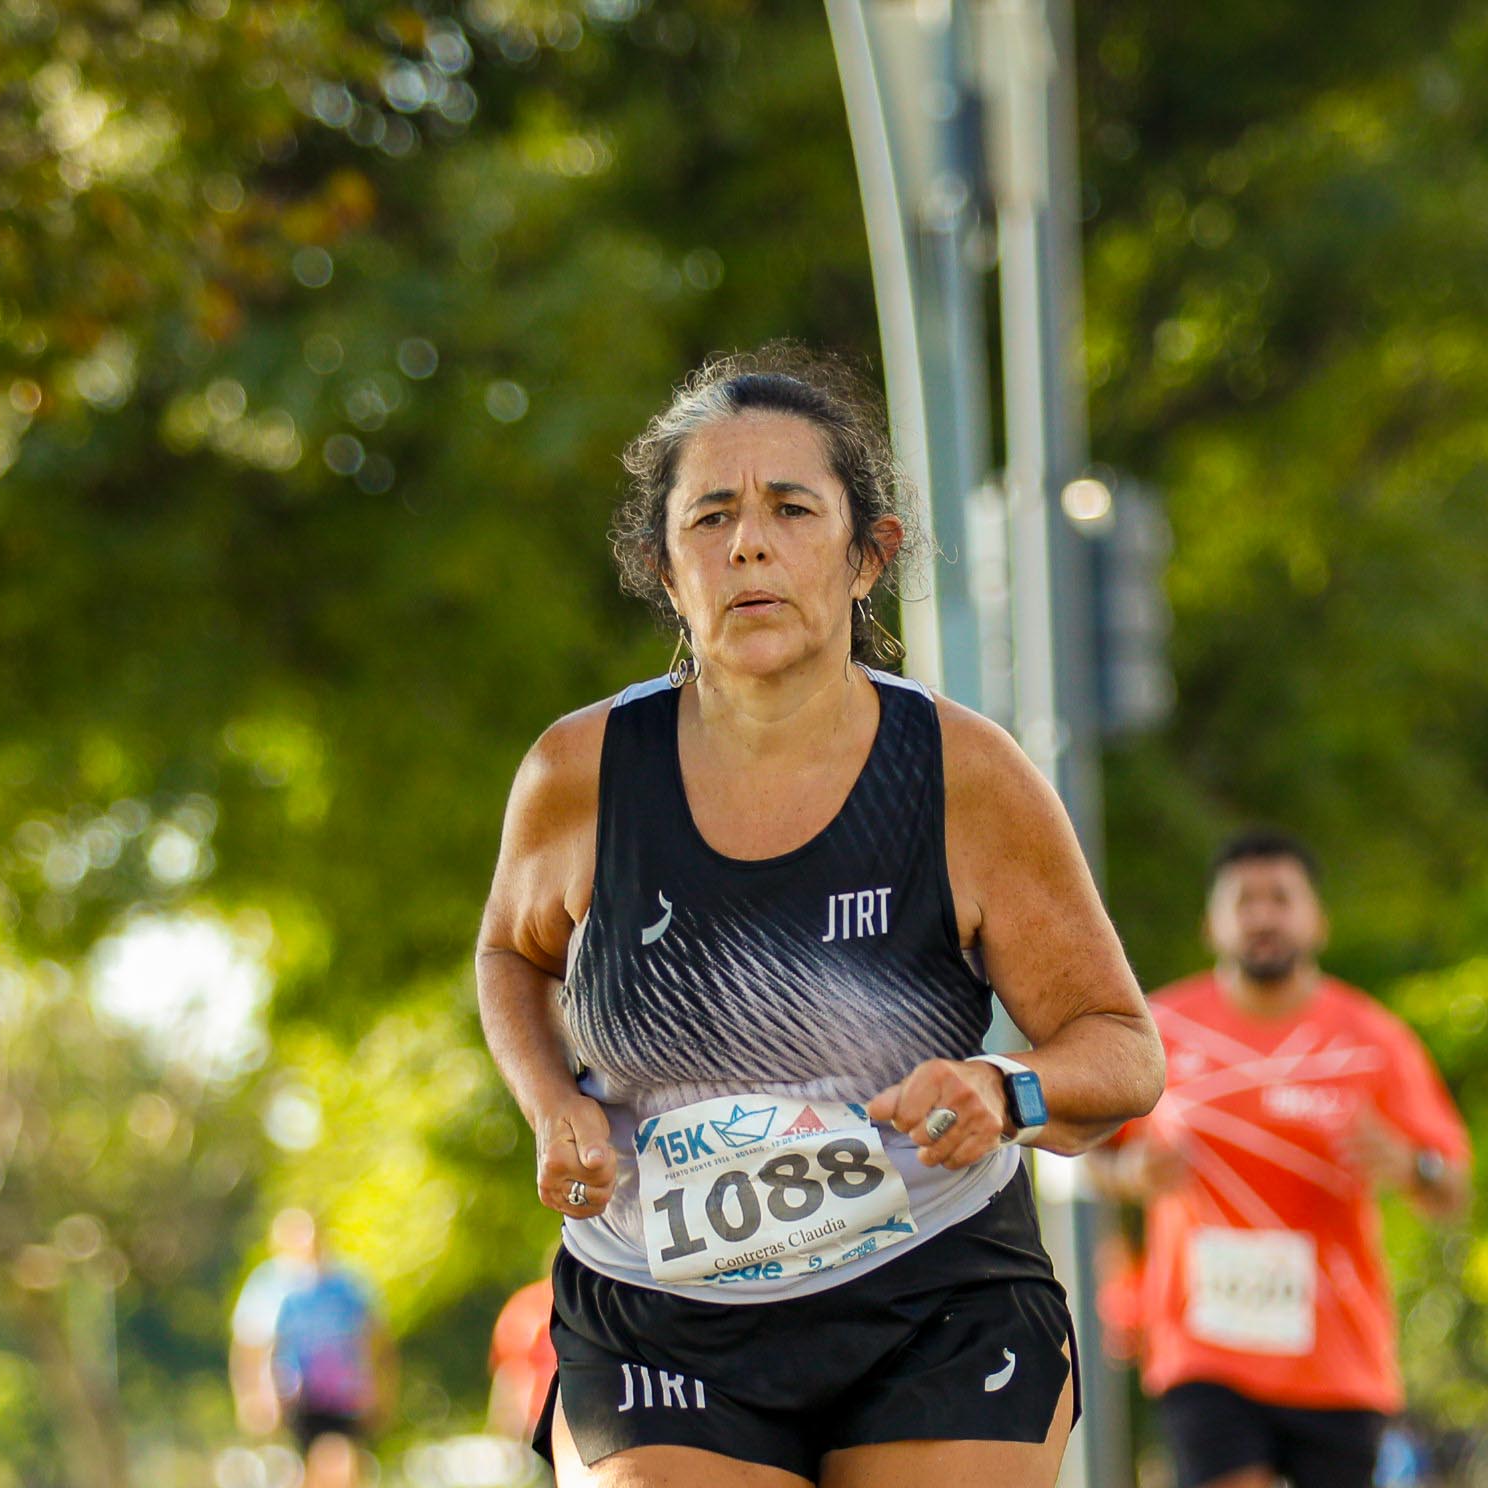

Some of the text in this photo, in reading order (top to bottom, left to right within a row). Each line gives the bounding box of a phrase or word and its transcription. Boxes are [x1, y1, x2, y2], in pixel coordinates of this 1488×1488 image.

[822, 887, 892, 943] JTRT
[655, 1123, 716, 1168] 15K
[653, 1138, 884, 1263] 1088
[714, 1217, 847, 1271] Contreras Claudia
